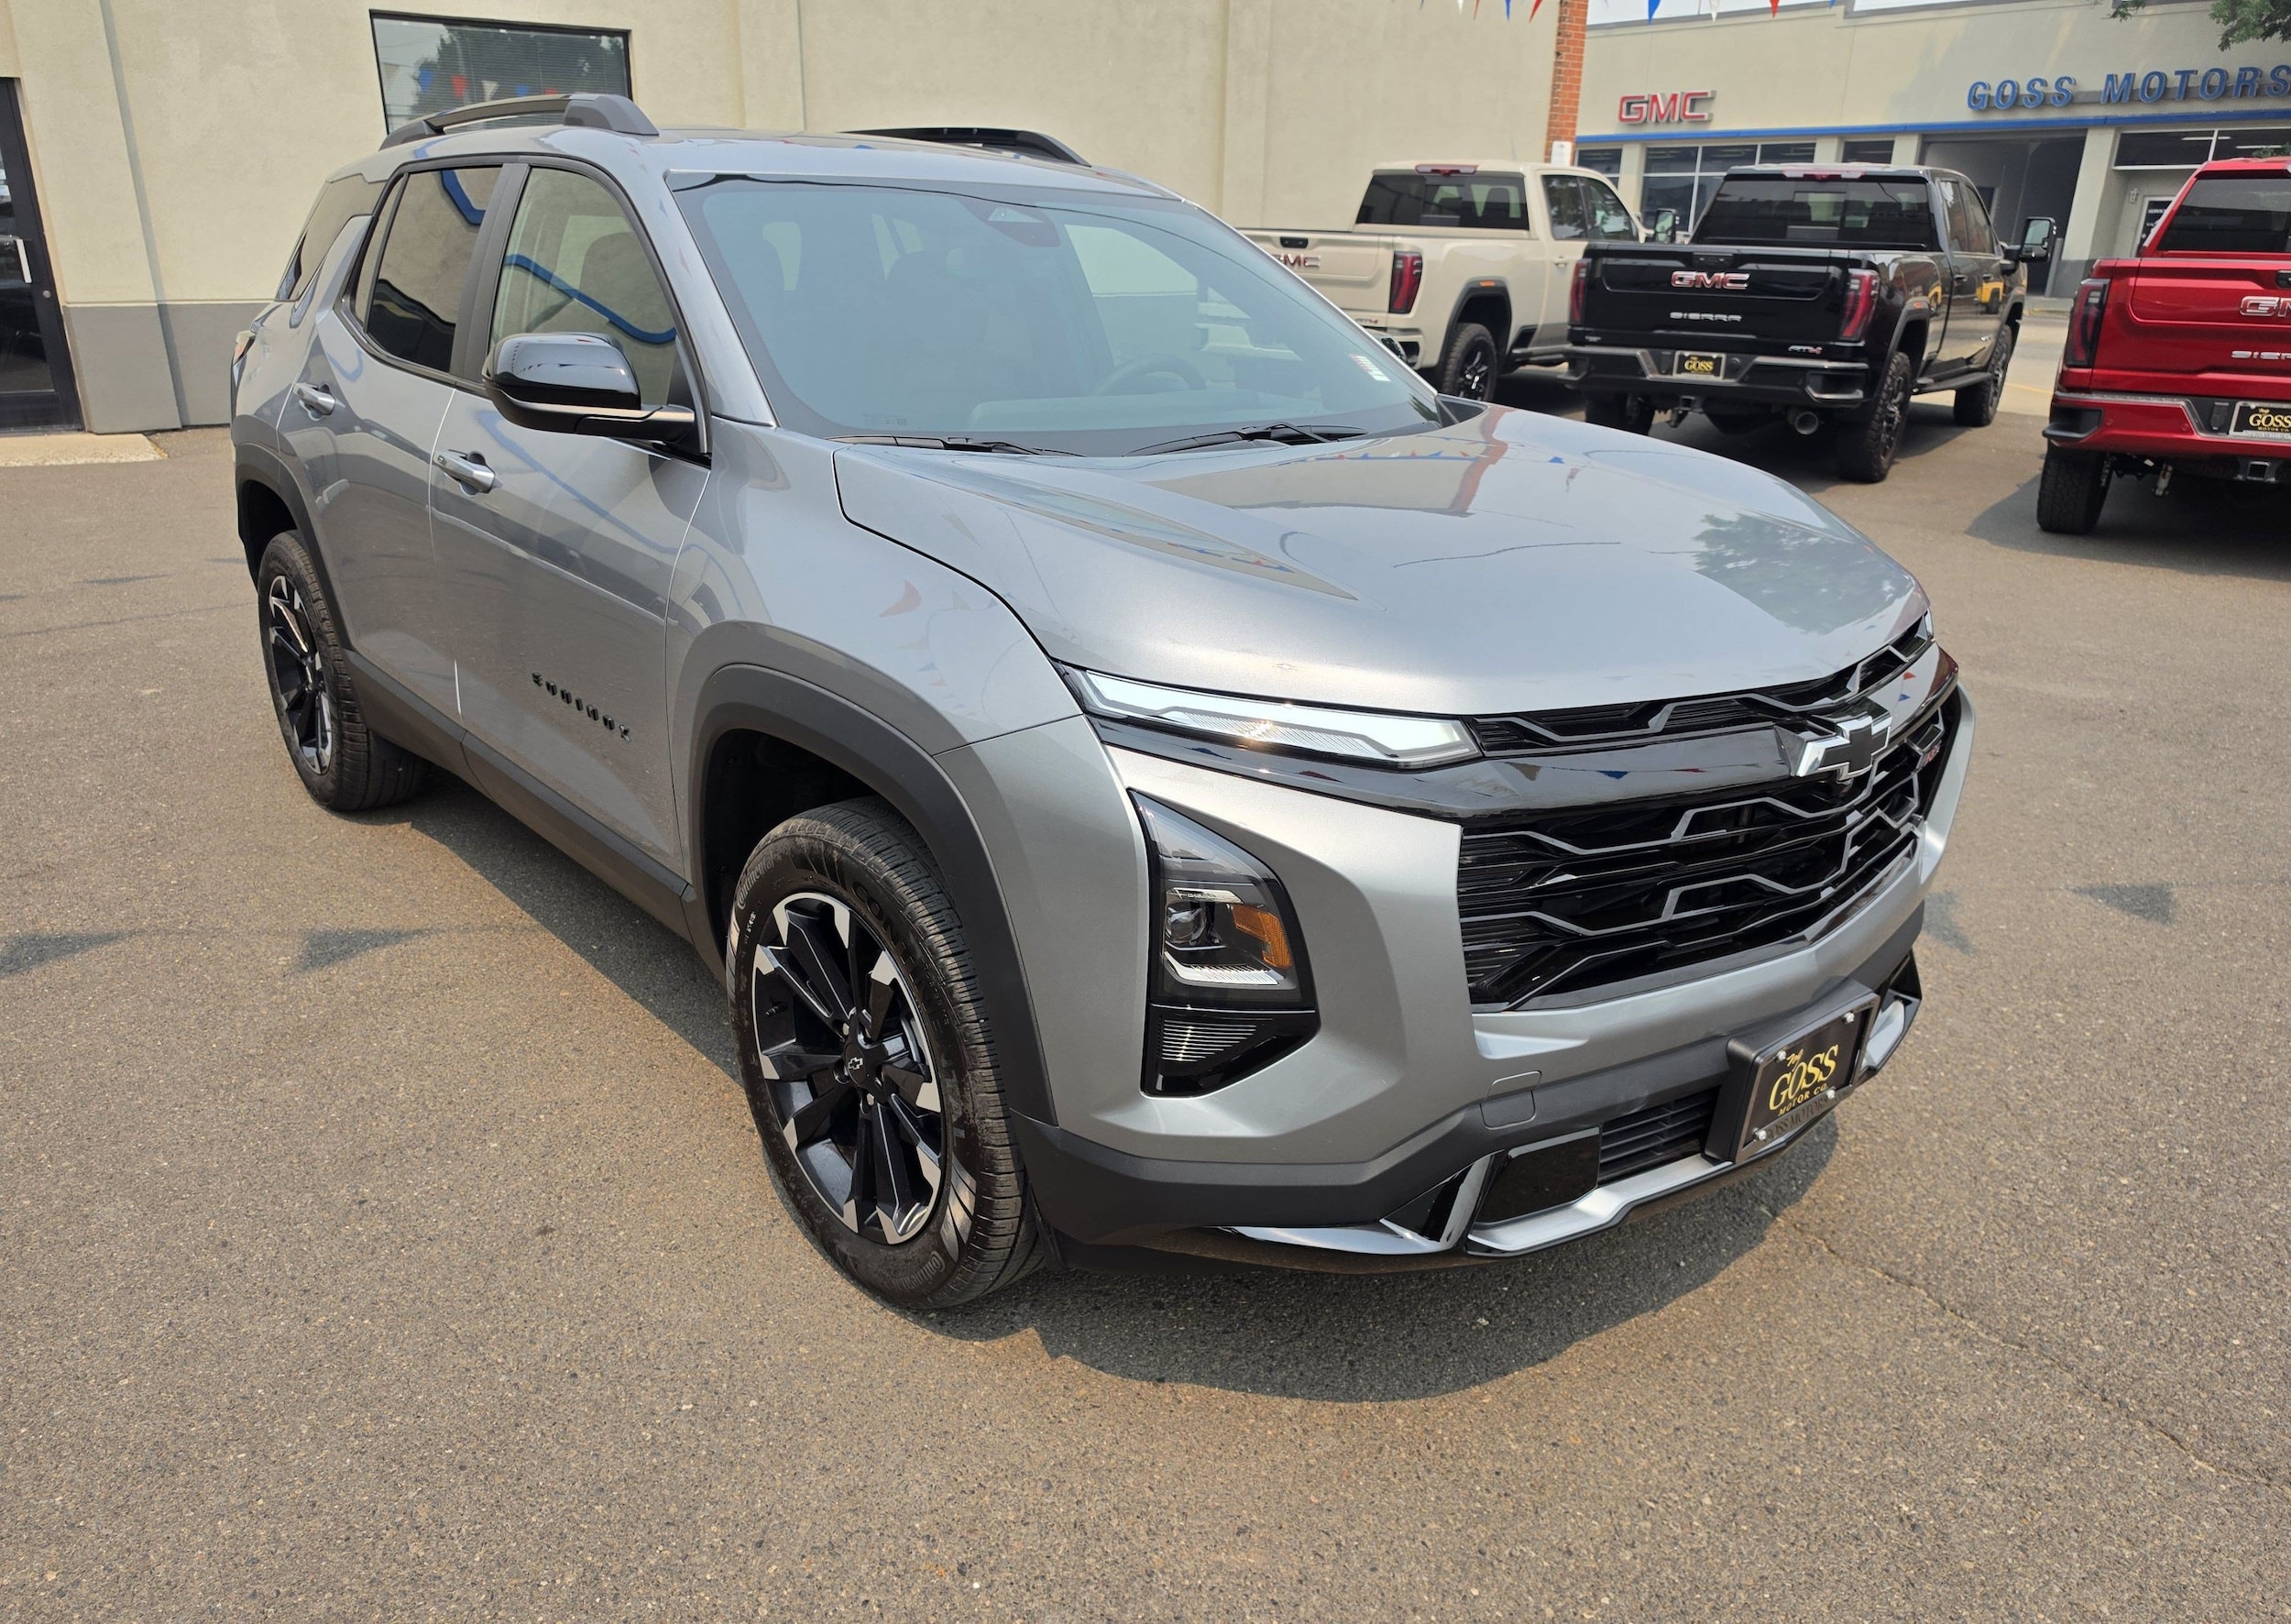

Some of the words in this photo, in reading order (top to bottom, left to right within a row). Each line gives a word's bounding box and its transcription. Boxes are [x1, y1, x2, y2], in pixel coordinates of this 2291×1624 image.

[1967, 75, 2076, 112] GOSS
[2099, 63, 2291, 104] MOTORS
[1618, 91, 1715, 124] GMC
[1671, 270, 1750, 290] GMC
[1669, 312, 1742, 323] SIERRA
[1683, 358, 1715, 372] GOSS
[2249, 412, 2291, 429] GOSS
[532, 672, 631, 742] EQUINOX
[1769, 1044, 1839, 1112] GOSS
[1778, 1091, 1811, 1117] MOTOR
